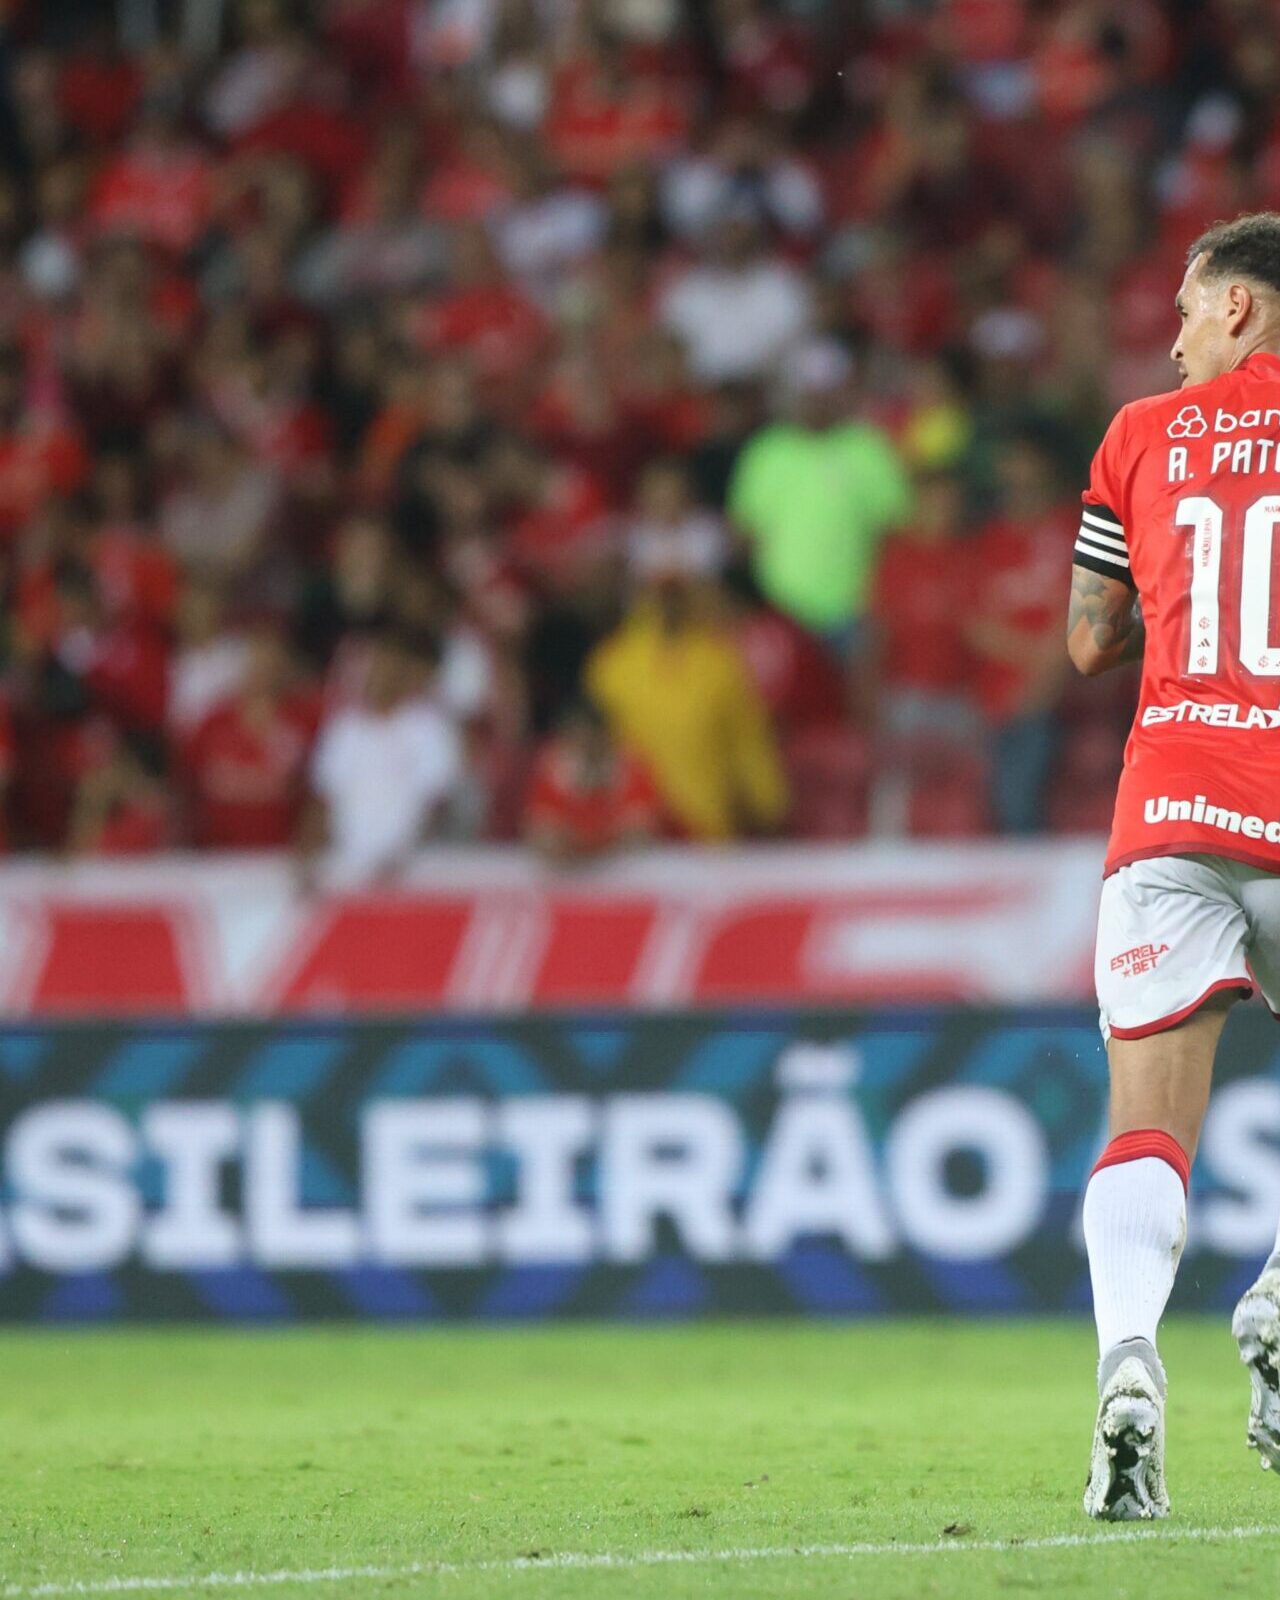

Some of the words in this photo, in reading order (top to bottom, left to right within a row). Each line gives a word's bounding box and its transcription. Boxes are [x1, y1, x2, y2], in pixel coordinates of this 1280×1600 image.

[1168, 446, 1195, 482] A.
[1141, 700, 1267, 729] ESTRELA
[1110, 943, 1170, 971] ESTRELA
[1132, 955, 1158, 976] BET
[0, 1043, 1048, 1270] SILEIRÃO
